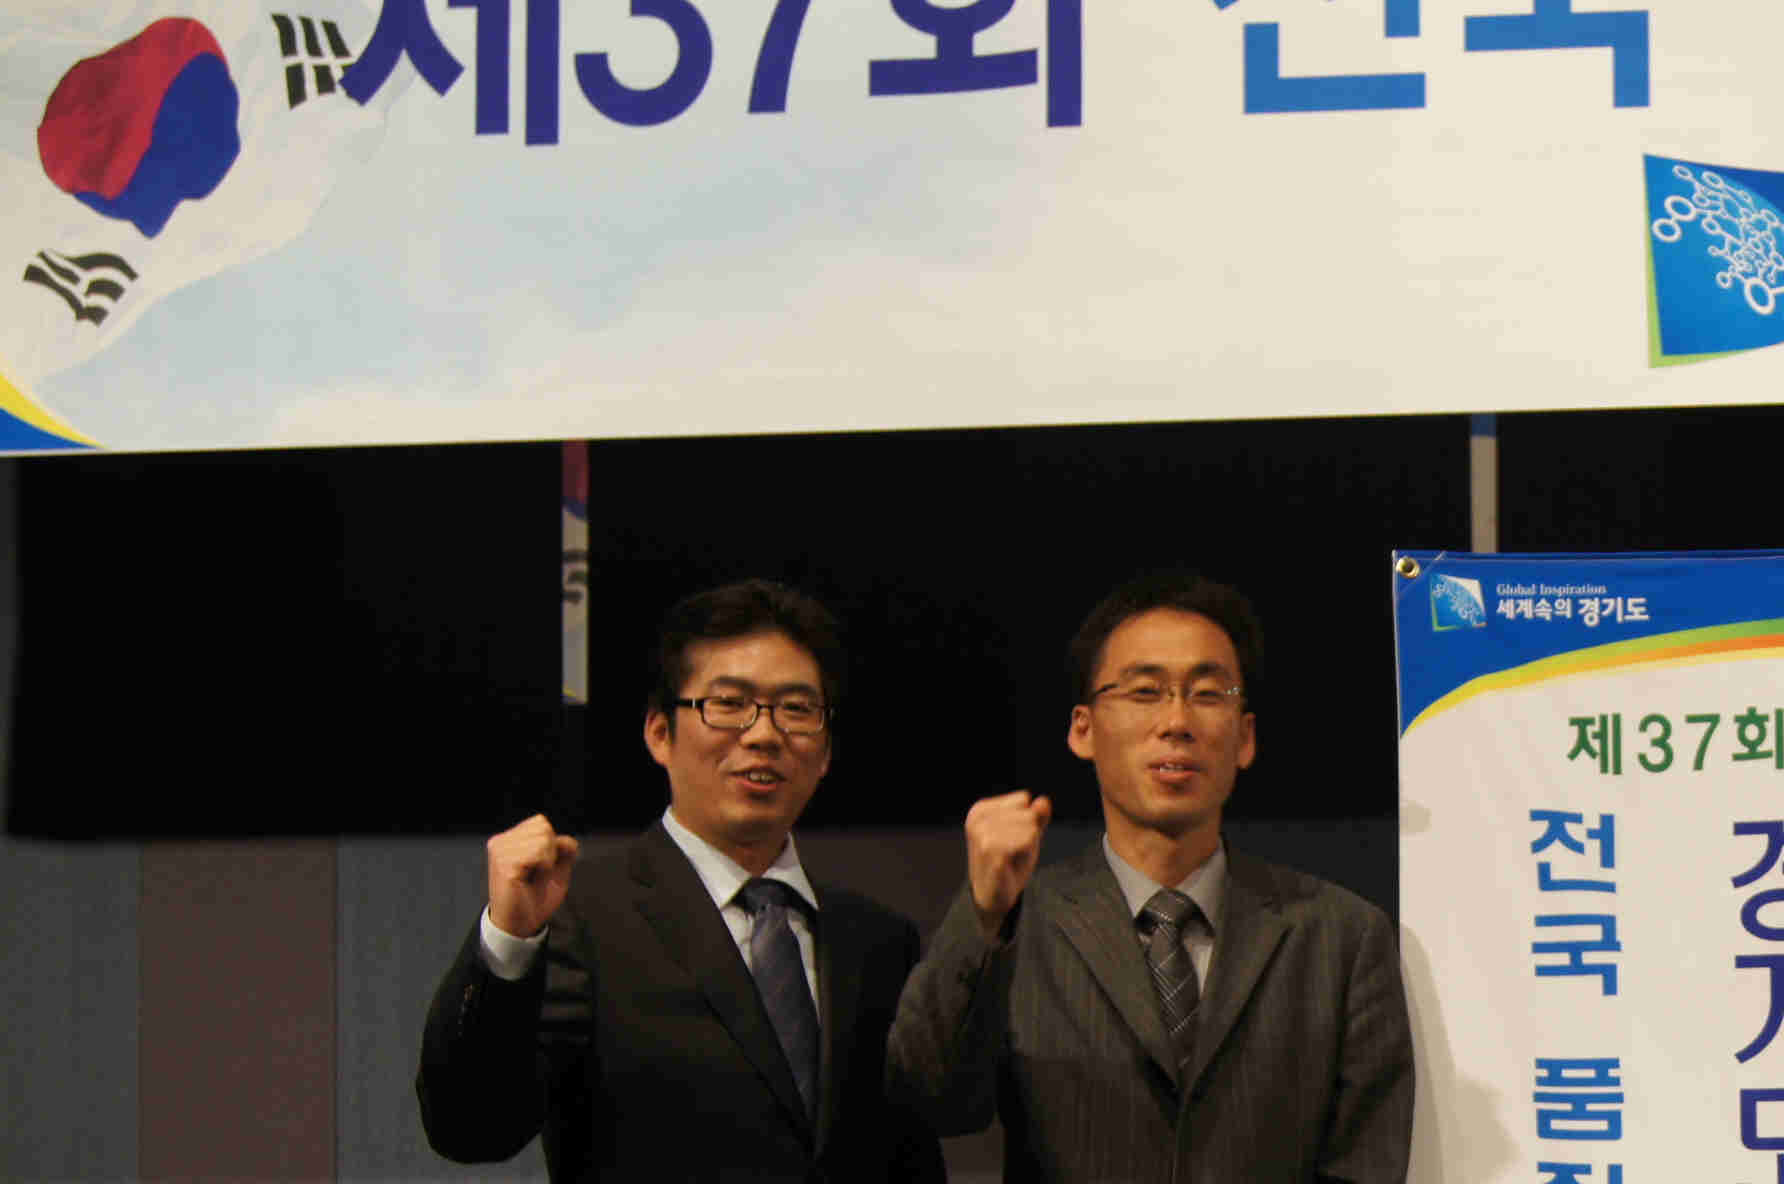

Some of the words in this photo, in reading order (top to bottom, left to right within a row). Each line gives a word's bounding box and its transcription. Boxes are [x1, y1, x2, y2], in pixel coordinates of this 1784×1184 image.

[1496, 583, 1537, 596] Global
[1540, 583, 1607, 597] Inspiration
[1496, 597, 1573, 621] 세계속의
[1578, 596, 1650, 627] 경기도
[1566, 705, 1784, 776] 제37회
[1529, 808, 1622, 997] 전국
